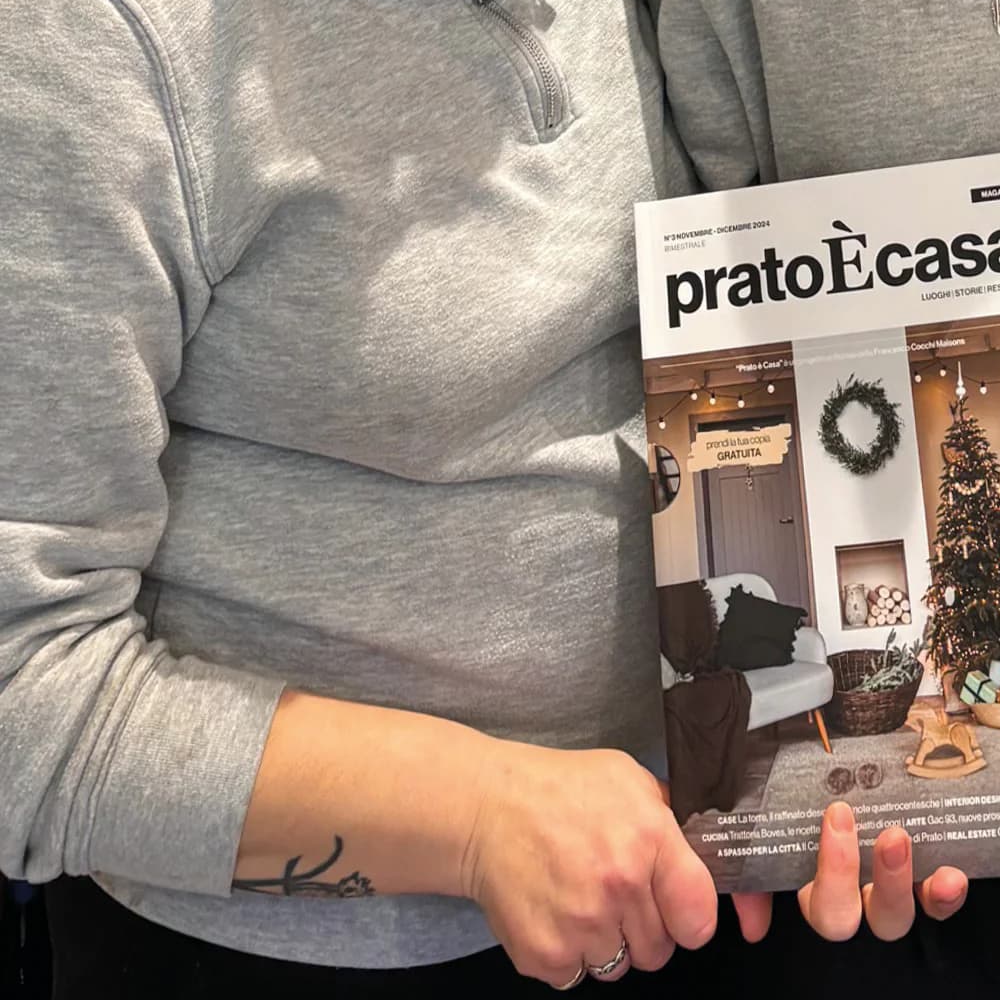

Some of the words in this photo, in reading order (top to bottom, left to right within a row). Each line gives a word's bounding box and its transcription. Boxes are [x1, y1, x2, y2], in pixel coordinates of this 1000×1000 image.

[676, 228, 713, 240] NOVEMBRE
[716, 222, 752, 234] DICEMBRE
[753, 220, 770, 229] 2024
[664, 240, 705, 252] BIMESTRALE
[911, 340, 935, 351] Cocchi
[936, 338, 966, 348] Maisons
[706, 440, 729, 450] prendi
[717, 447, 762, 461] GRATUITA
[717, 814, 737, 824] CASE
[738, 813, 748, 823] La
[774, 809, 806, 819] raffinato
[872, 800, 940, 814] quattrocentesche
[945, 796, 979, 807] INTERIOR
[702, 832, 729, 842] CUCINA
[905, 816, 926, 827] ARTE
[724, 848, 752, 858] SPASSO
[753, 846, 768, 856] PER
[769, 845, 780, 855] LA
[922, 832, 944, 843] Prato
[947, 830, 968, 841] REAL
[968, 828, 997, 839] ESTATE
